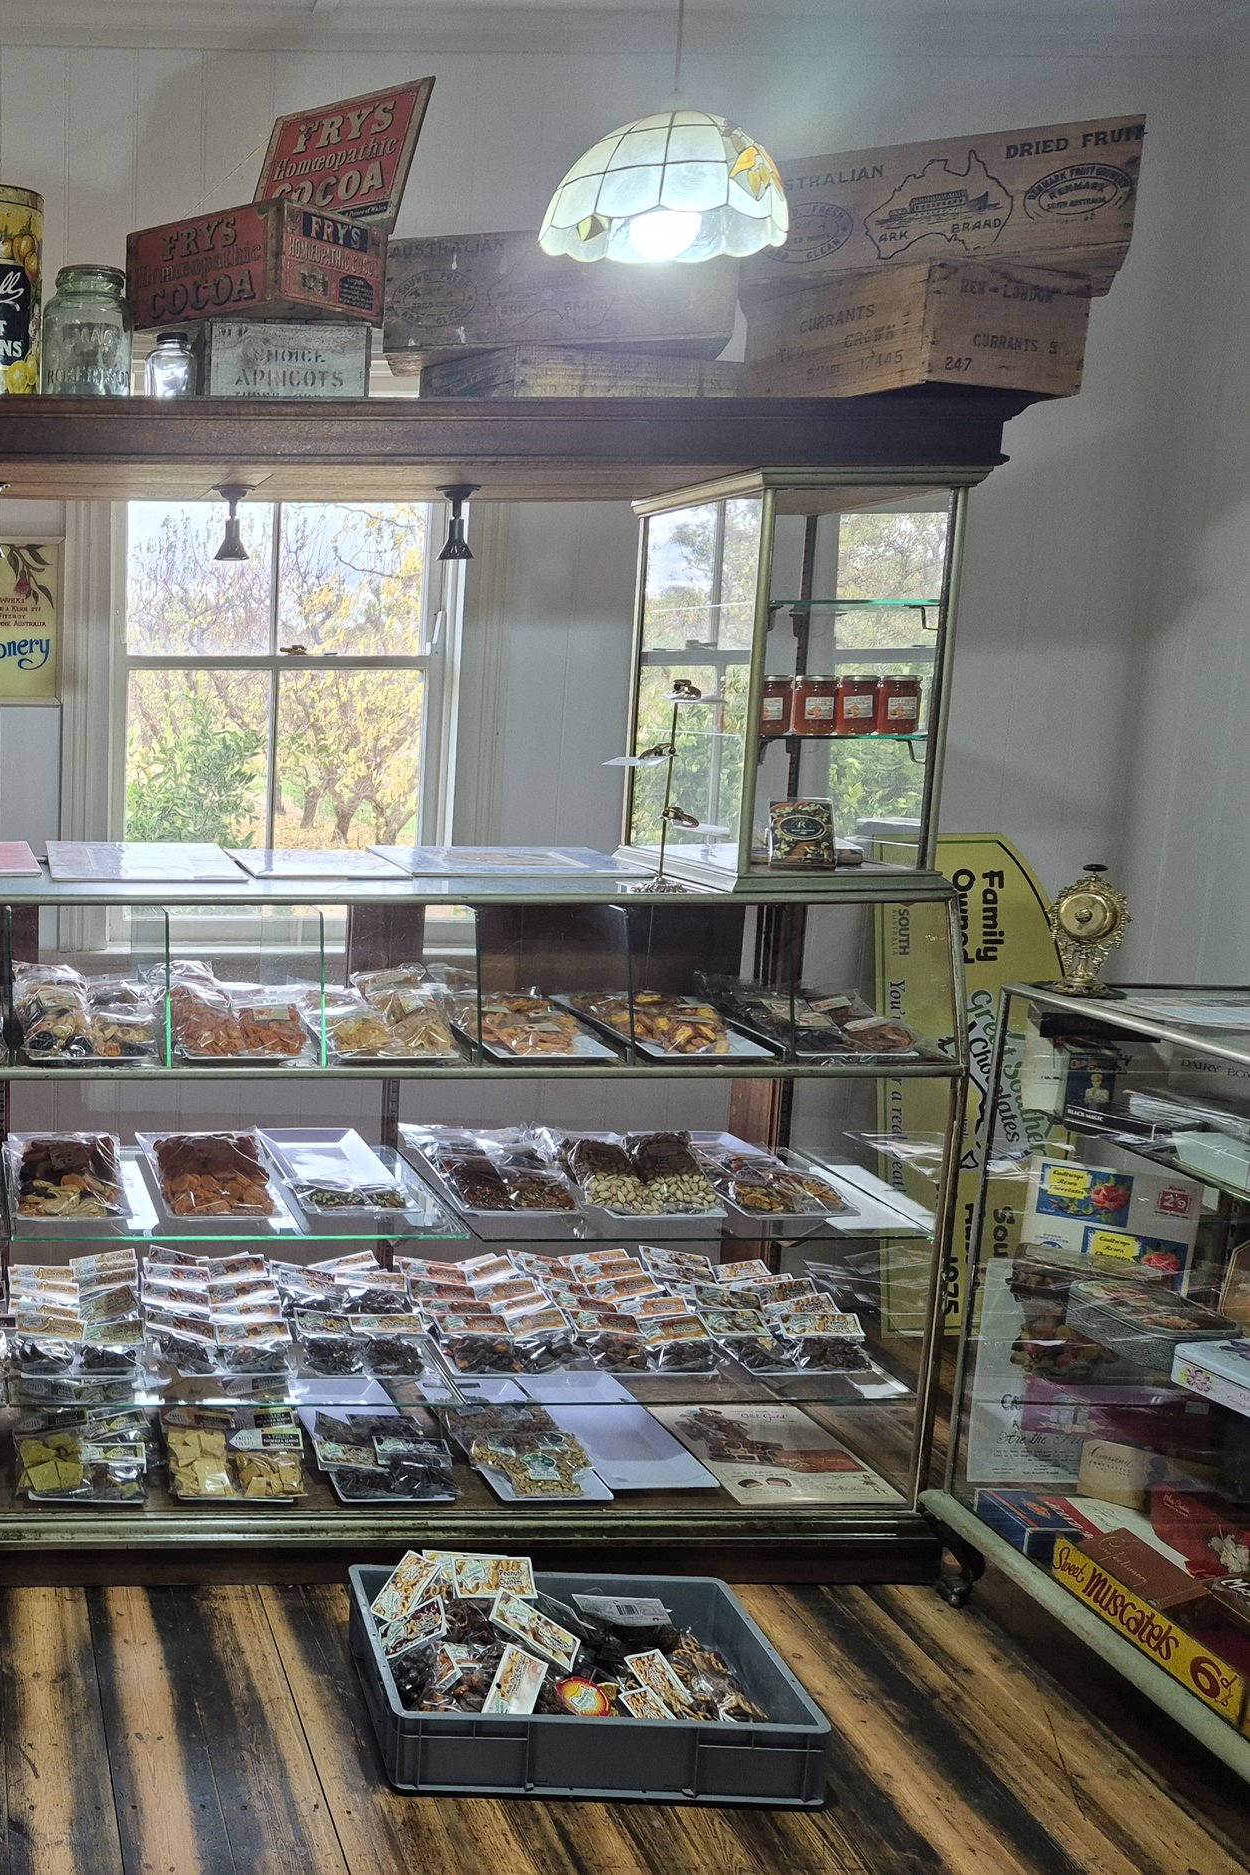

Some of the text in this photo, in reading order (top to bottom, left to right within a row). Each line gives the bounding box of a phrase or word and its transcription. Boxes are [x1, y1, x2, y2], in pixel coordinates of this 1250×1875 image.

[1005, 138, 1070, 160] DRIED
[271, 160, 385, 208] COCOA
[783, 164, 885, 193] STRALIAN
[879, 217, 1002, 243] ARK BRAND
[147, 269, 257, 320] COCOA
[800, 304, 876, 333] CURRANTS
[973, 333, 1039, 353] CURRANTS
[235, 368, 344, 388] APRICOTS
[944, 356, 973, 372] 247
[975, 870, 1005, 962] Family
[898, 908, 910, 956] SOUTH
[1181, 1058, 1222, 1073] DAIRY
[993, 1206, 1016, 1258] Sou
[499, 1569, 523, 1577] Peanut
[1053, 1546, 1086, 1584] Sweet
